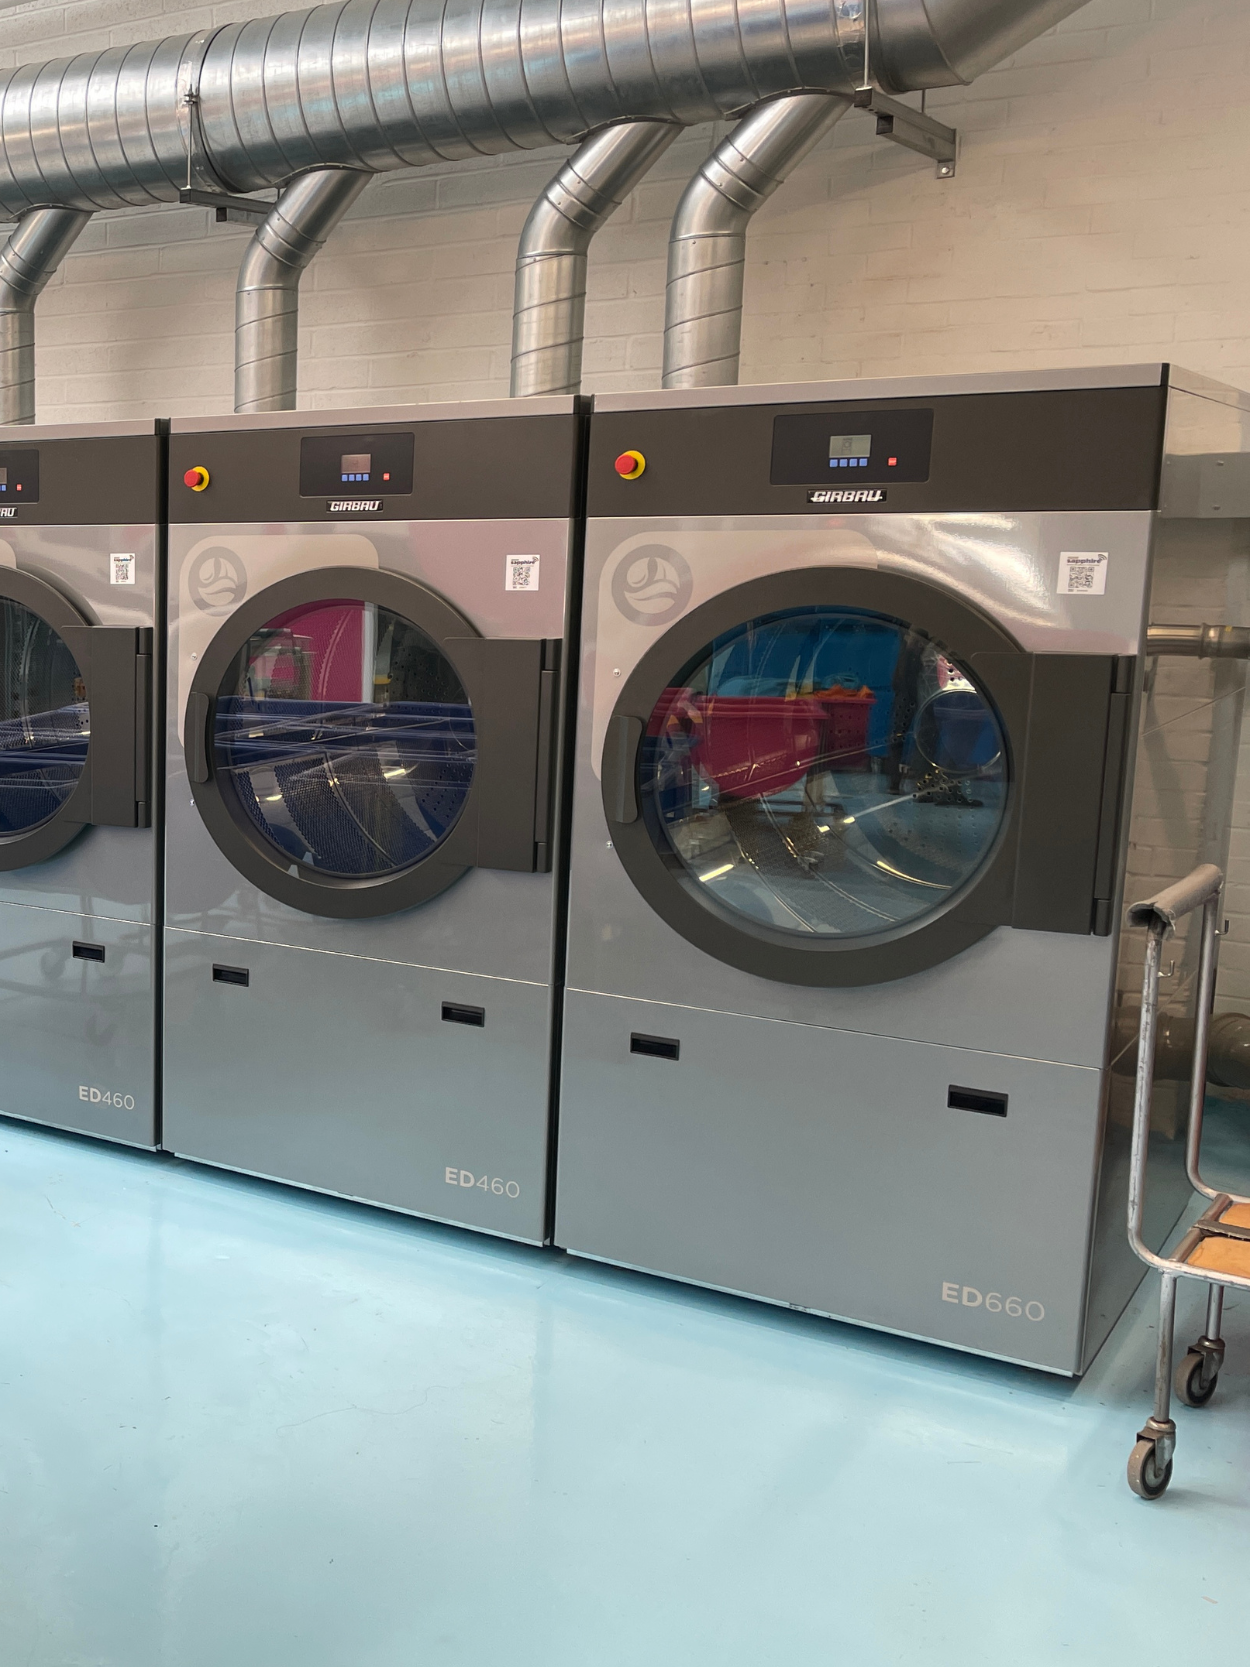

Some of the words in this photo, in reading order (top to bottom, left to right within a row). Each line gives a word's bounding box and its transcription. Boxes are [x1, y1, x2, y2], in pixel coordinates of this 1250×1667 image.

[330, 501, 380, 511] GIRBAU
[810, 490, 882, 502] GIRBAU
[78, 1085, 135, 1110] ED460
[445, 1166, 520, 1198] ED460
[941, 1281, 1045, 1321] ED660
